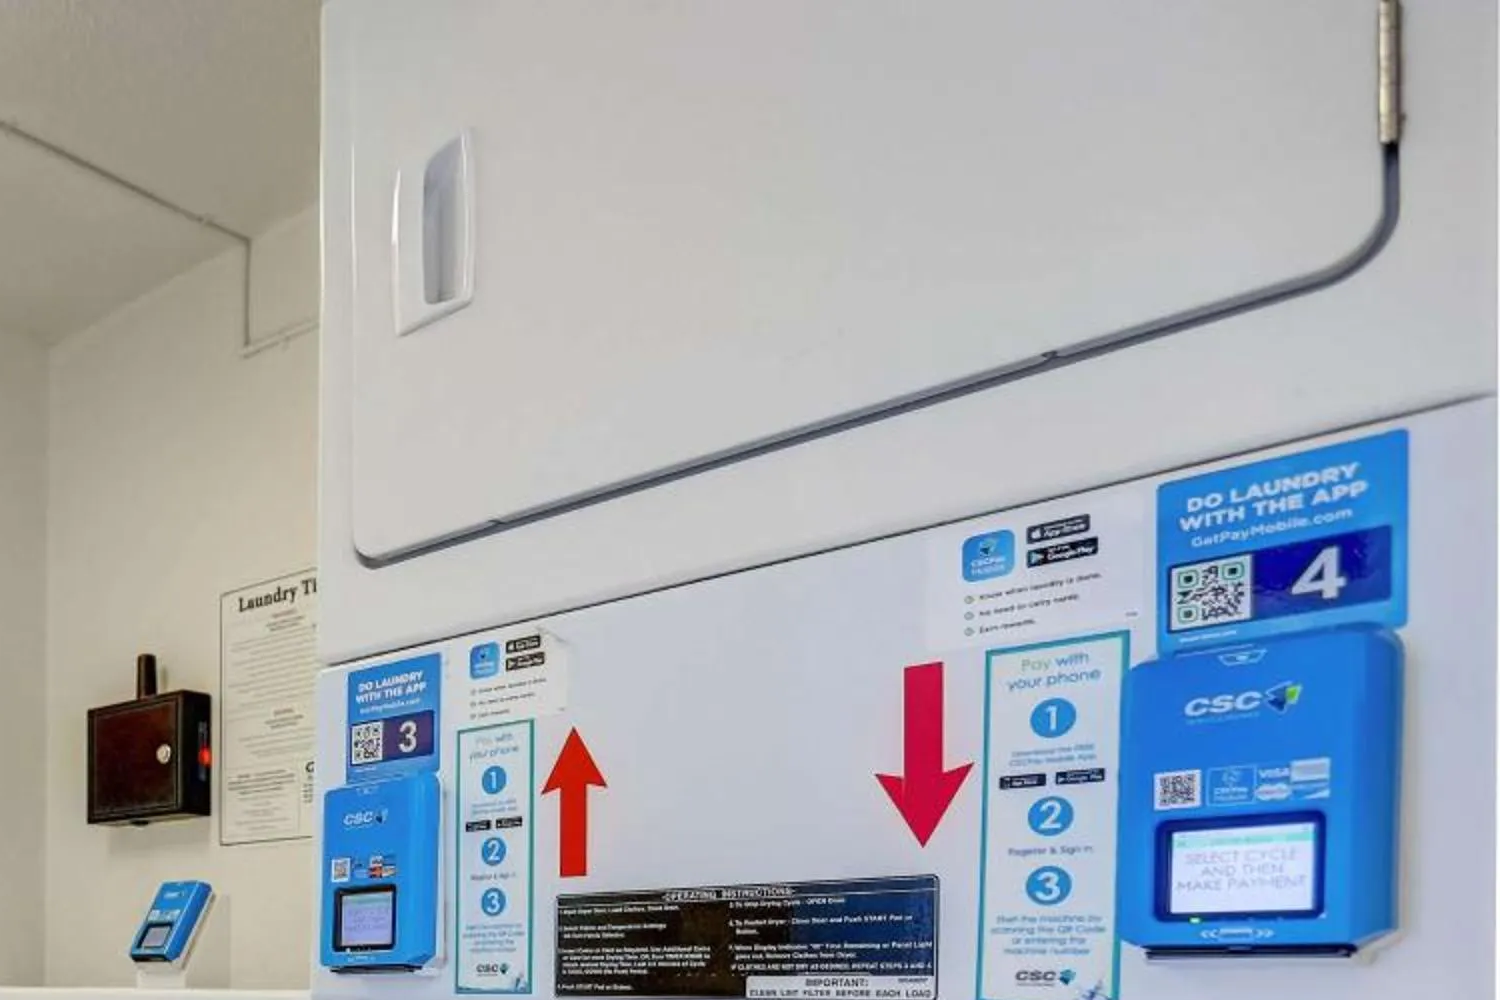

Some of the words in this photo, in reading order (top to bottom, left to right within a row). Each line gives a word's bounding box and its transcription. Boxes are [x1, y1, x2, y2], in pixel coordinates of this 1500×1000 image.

[1187, 493, 1223, 513] DO
[1230, 462, 1360, 504] LAUNDRY
[1179, 506, 1245, 532] WITH
[1252, 493, 1303, 517] THE
[1312, 480, 1369, 506] APP
[1191, 508, 1353, 548] GetPayMobile.com
[1291, 546, 1347, 599] 4
[238, 585, 298, 613] Laundry
[1021, 658, 1051, 672] Pay
[1055, 652, 1089, 668] with
[358, 681, 373, 693] DO
[376, 670, 424, 688] LAUNDRY
[1007, 676, 1043, 692] your
[1046, 669, 1101, 688] phone
[356, 690, 382, 704] WITH
[384, 686, 404, 699] THE
[406, 681, 427, 694] APP
[1184, 690, 1263, 718] CSC
[1045, 705, 1058, 731] 1
[399, 720, 417, 753] 3
[490, 771, 497, 789] 1
[343, 811, 373, 826] CSC
[1040, 801, 1062, 829] 2
[487, 840, 501, 861] 2
[1184, 849, 1240, 865] SELECT
[1245, 847, 1299, 862] CYCLE
[1201, 864, 1235, 878] AND
[1242, 862, 1285, 877] THEN
[1035, 872, 1061, 901] 3
[1177, 877, 1222, 892] MAKE
[1227, 874, 1307, 891] PAYMENT
[487, 891, 501, 913] 3
[806, 977, 869, 987] IMPORTANT:
[1015, 970, 1057, 982] CSC
[749, 989, 777, 997] CLEAN
[836, 989, 870, 997] BEFORE
[876, 989, 901, 997] EACH
[905, 989, 931, 997] LOAD
